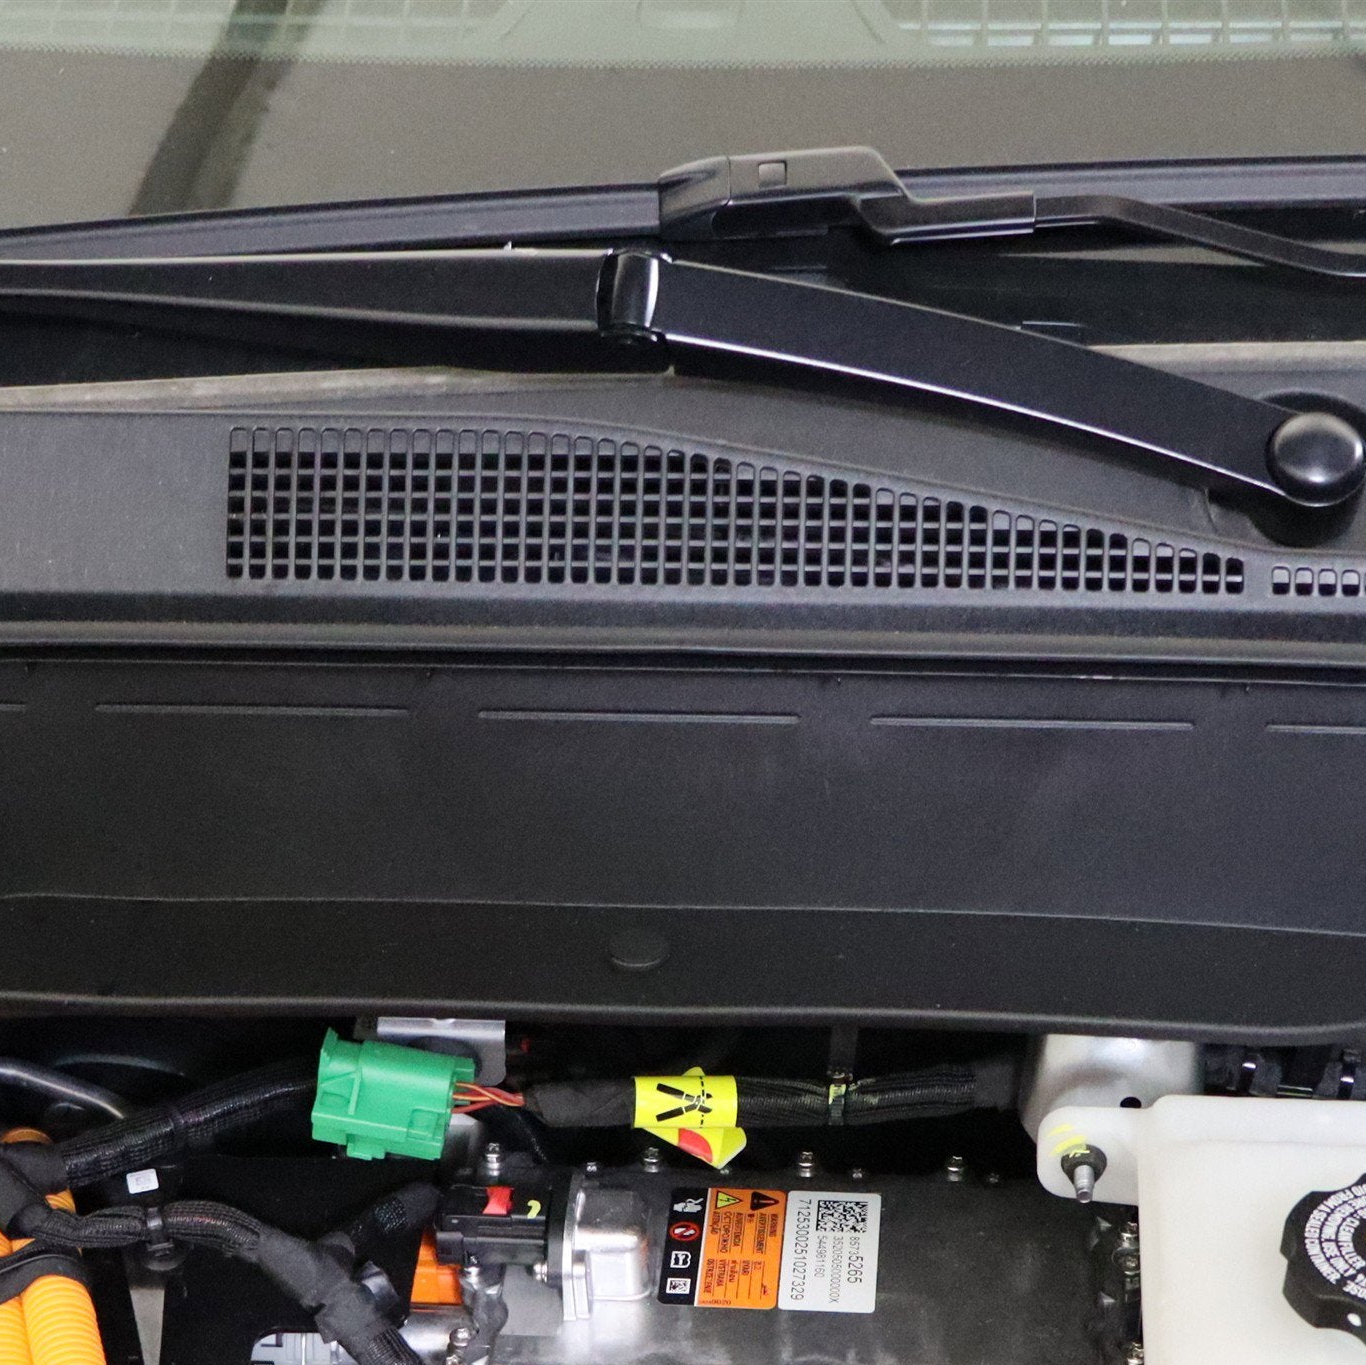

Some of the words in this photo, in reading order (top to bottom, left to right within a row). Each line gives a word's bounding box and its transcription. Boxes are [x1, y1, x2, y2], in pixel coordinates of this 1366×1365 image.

[1323, 1189, 1354, 1208] FROM
[756, 1213, 766, 1254] AVERTISSEMENT
[790, 1199, 812, 1301] 7125300251027329
